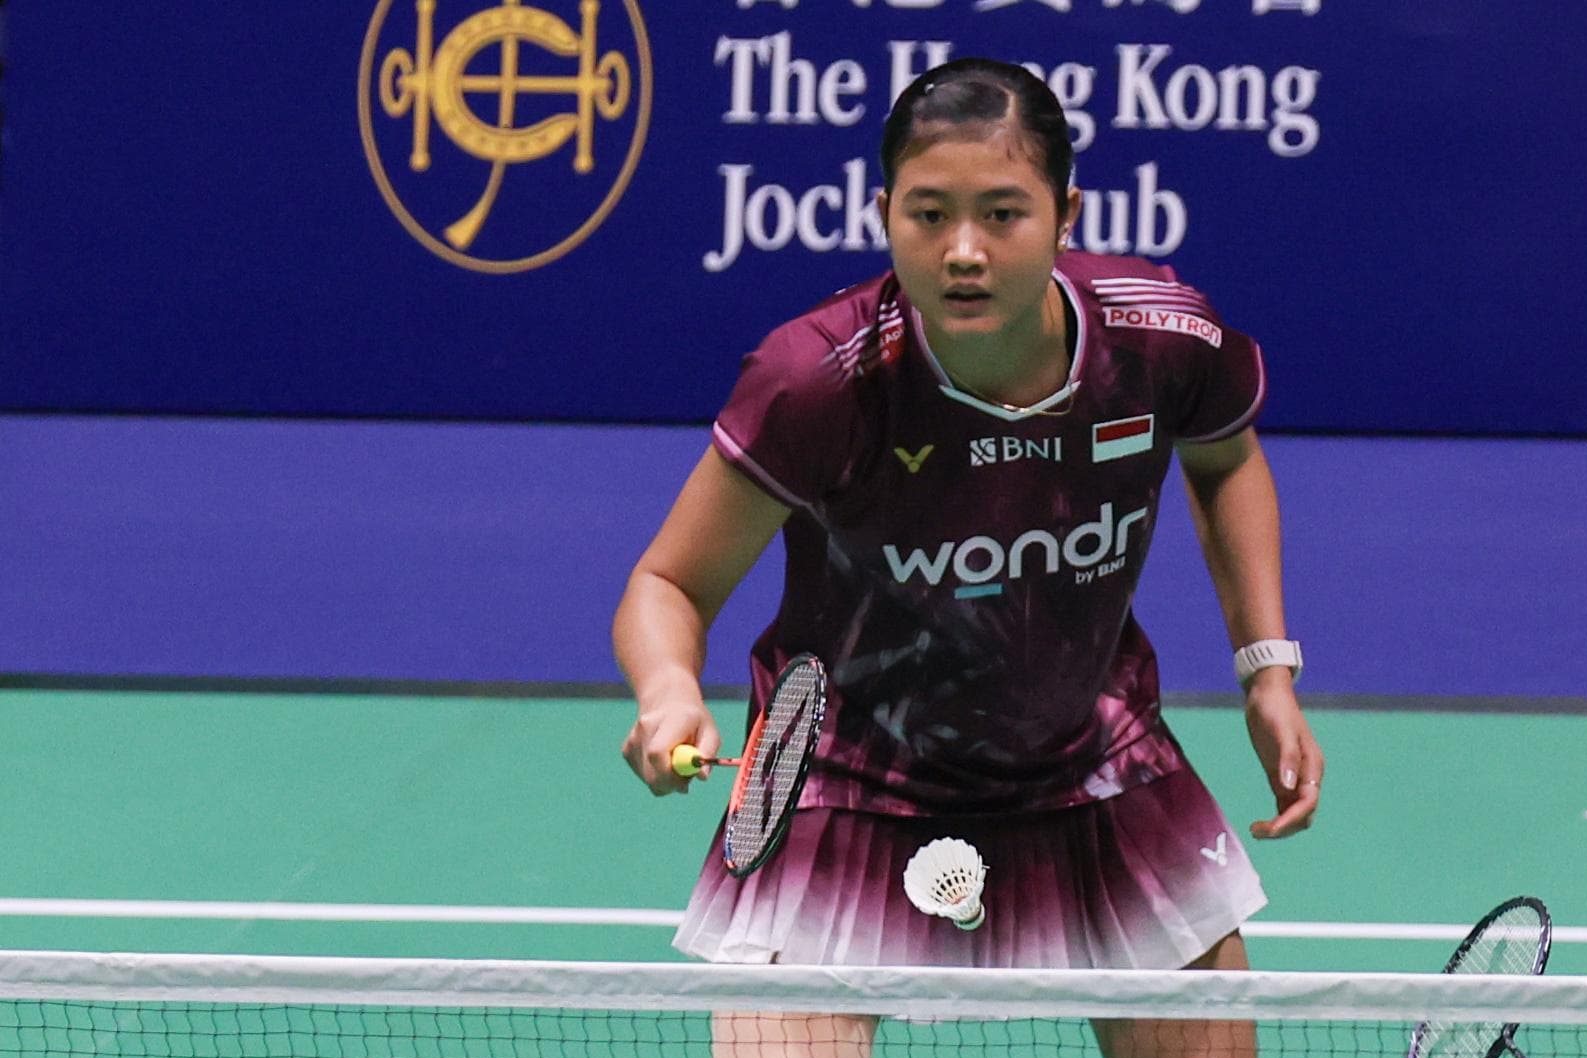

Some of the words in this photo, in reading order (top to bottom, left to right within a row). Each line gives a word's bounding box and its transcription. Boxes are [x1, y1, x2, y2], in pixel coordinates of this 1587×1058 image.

[714, 31, 866, 126] The
[1113, 43, 1321, 158] Kong
[702, 157, 888, 272] Jock
[1002, 437, 1061, 461] BNI
[884, 503, 1147, 585] wondr
